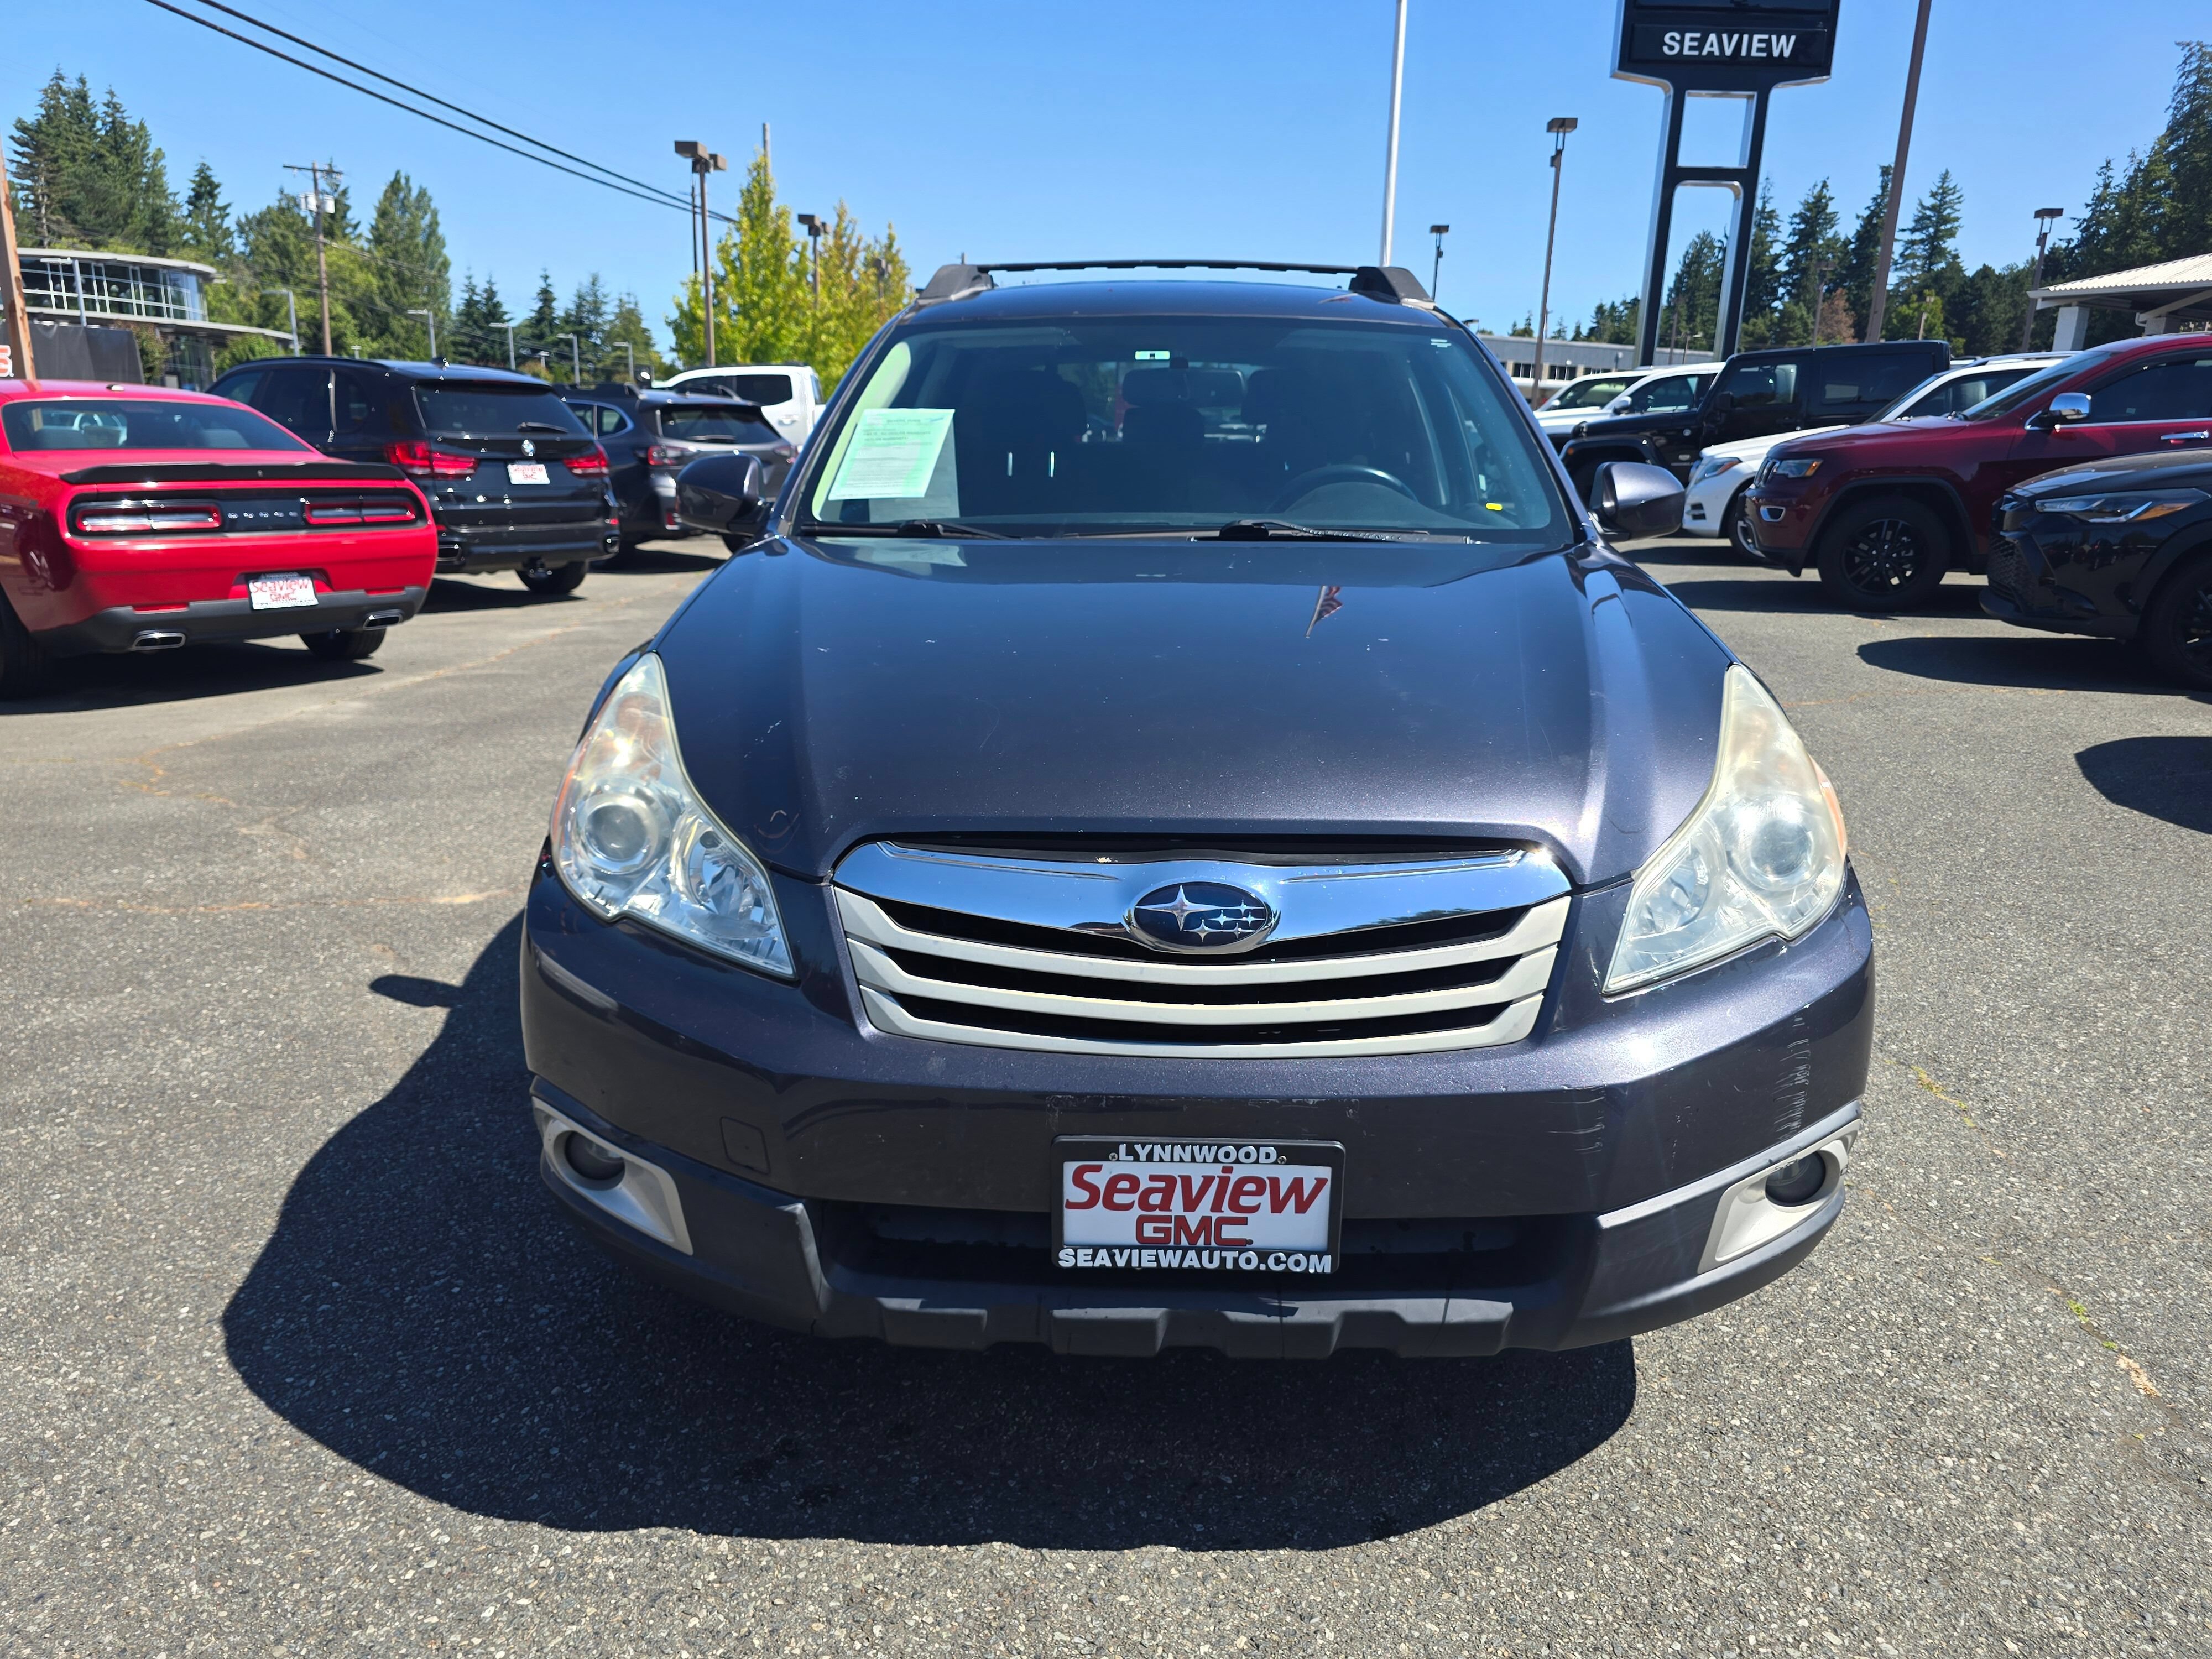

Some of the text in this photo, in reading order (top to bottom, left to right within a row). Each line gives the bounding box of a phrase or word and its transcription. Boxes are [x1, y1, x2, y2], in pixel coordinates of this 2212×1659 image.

[1662, 32, 1797, 58] SEAVIEW
[1118, 1144, 1277, 1164] LYNNWOOD
[1065, 1164, 1328, 1214] Seaview
[1135, 1215, 1248, 1246] GMC
[1058, 1248, 1332, 1274] SEAVIEWAUTO.COM
